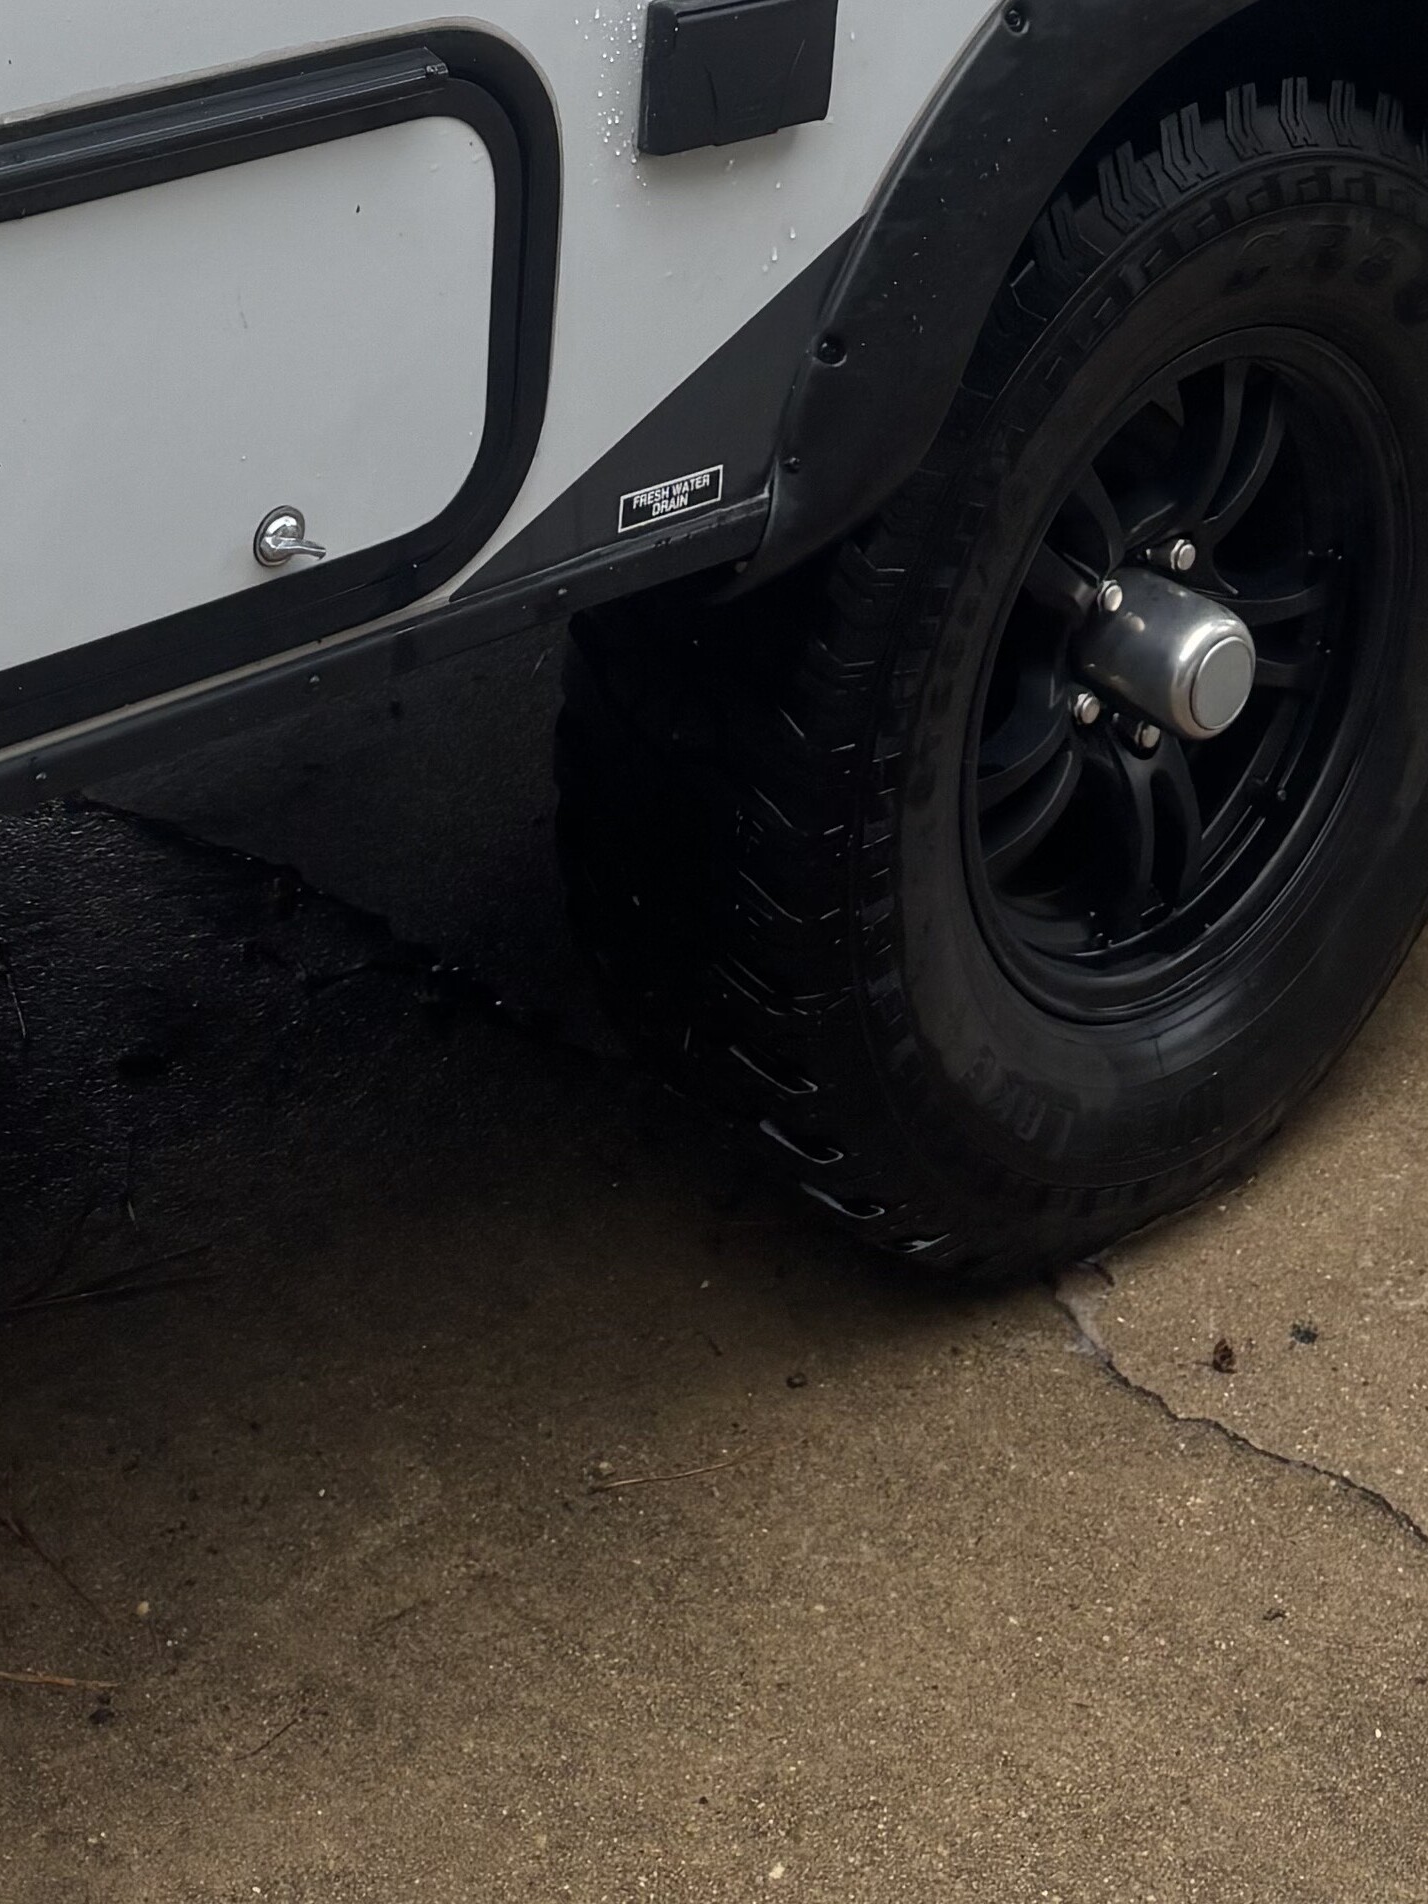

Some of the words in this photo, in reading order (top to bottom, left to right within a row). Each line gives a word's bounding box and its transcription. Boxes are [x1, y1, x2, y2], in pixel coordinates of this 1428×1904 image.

[632, 486, 670, 510] FRESH
[672, 474, 710, 496] WATER
[651, 494, 689, 517] DRAIN
